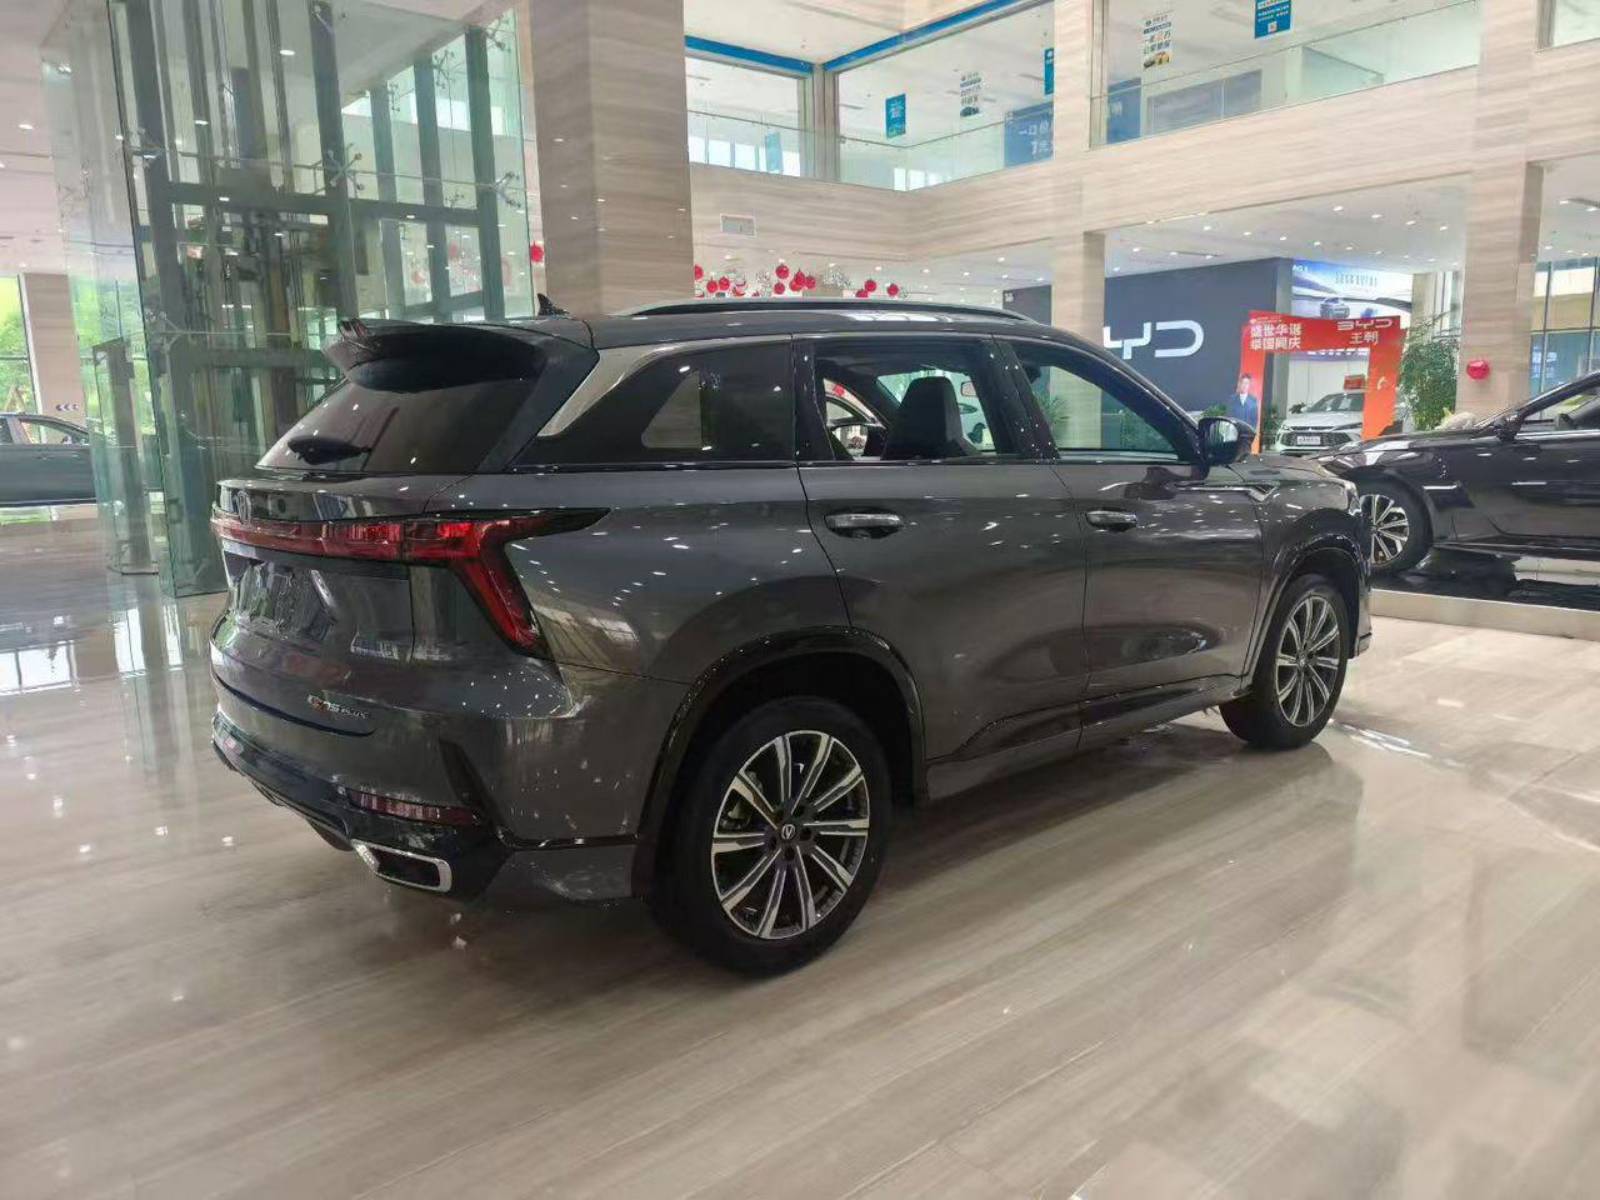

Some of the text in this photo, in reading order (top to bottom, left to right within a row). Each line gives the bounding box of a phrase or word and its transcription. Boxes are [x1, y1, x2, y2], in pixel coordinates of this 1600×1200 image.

[1336, 318, 1393, 331] BYD
[1103, 319, 1205, 361] YD
[1348, 330, 1379, 345] 王朝
